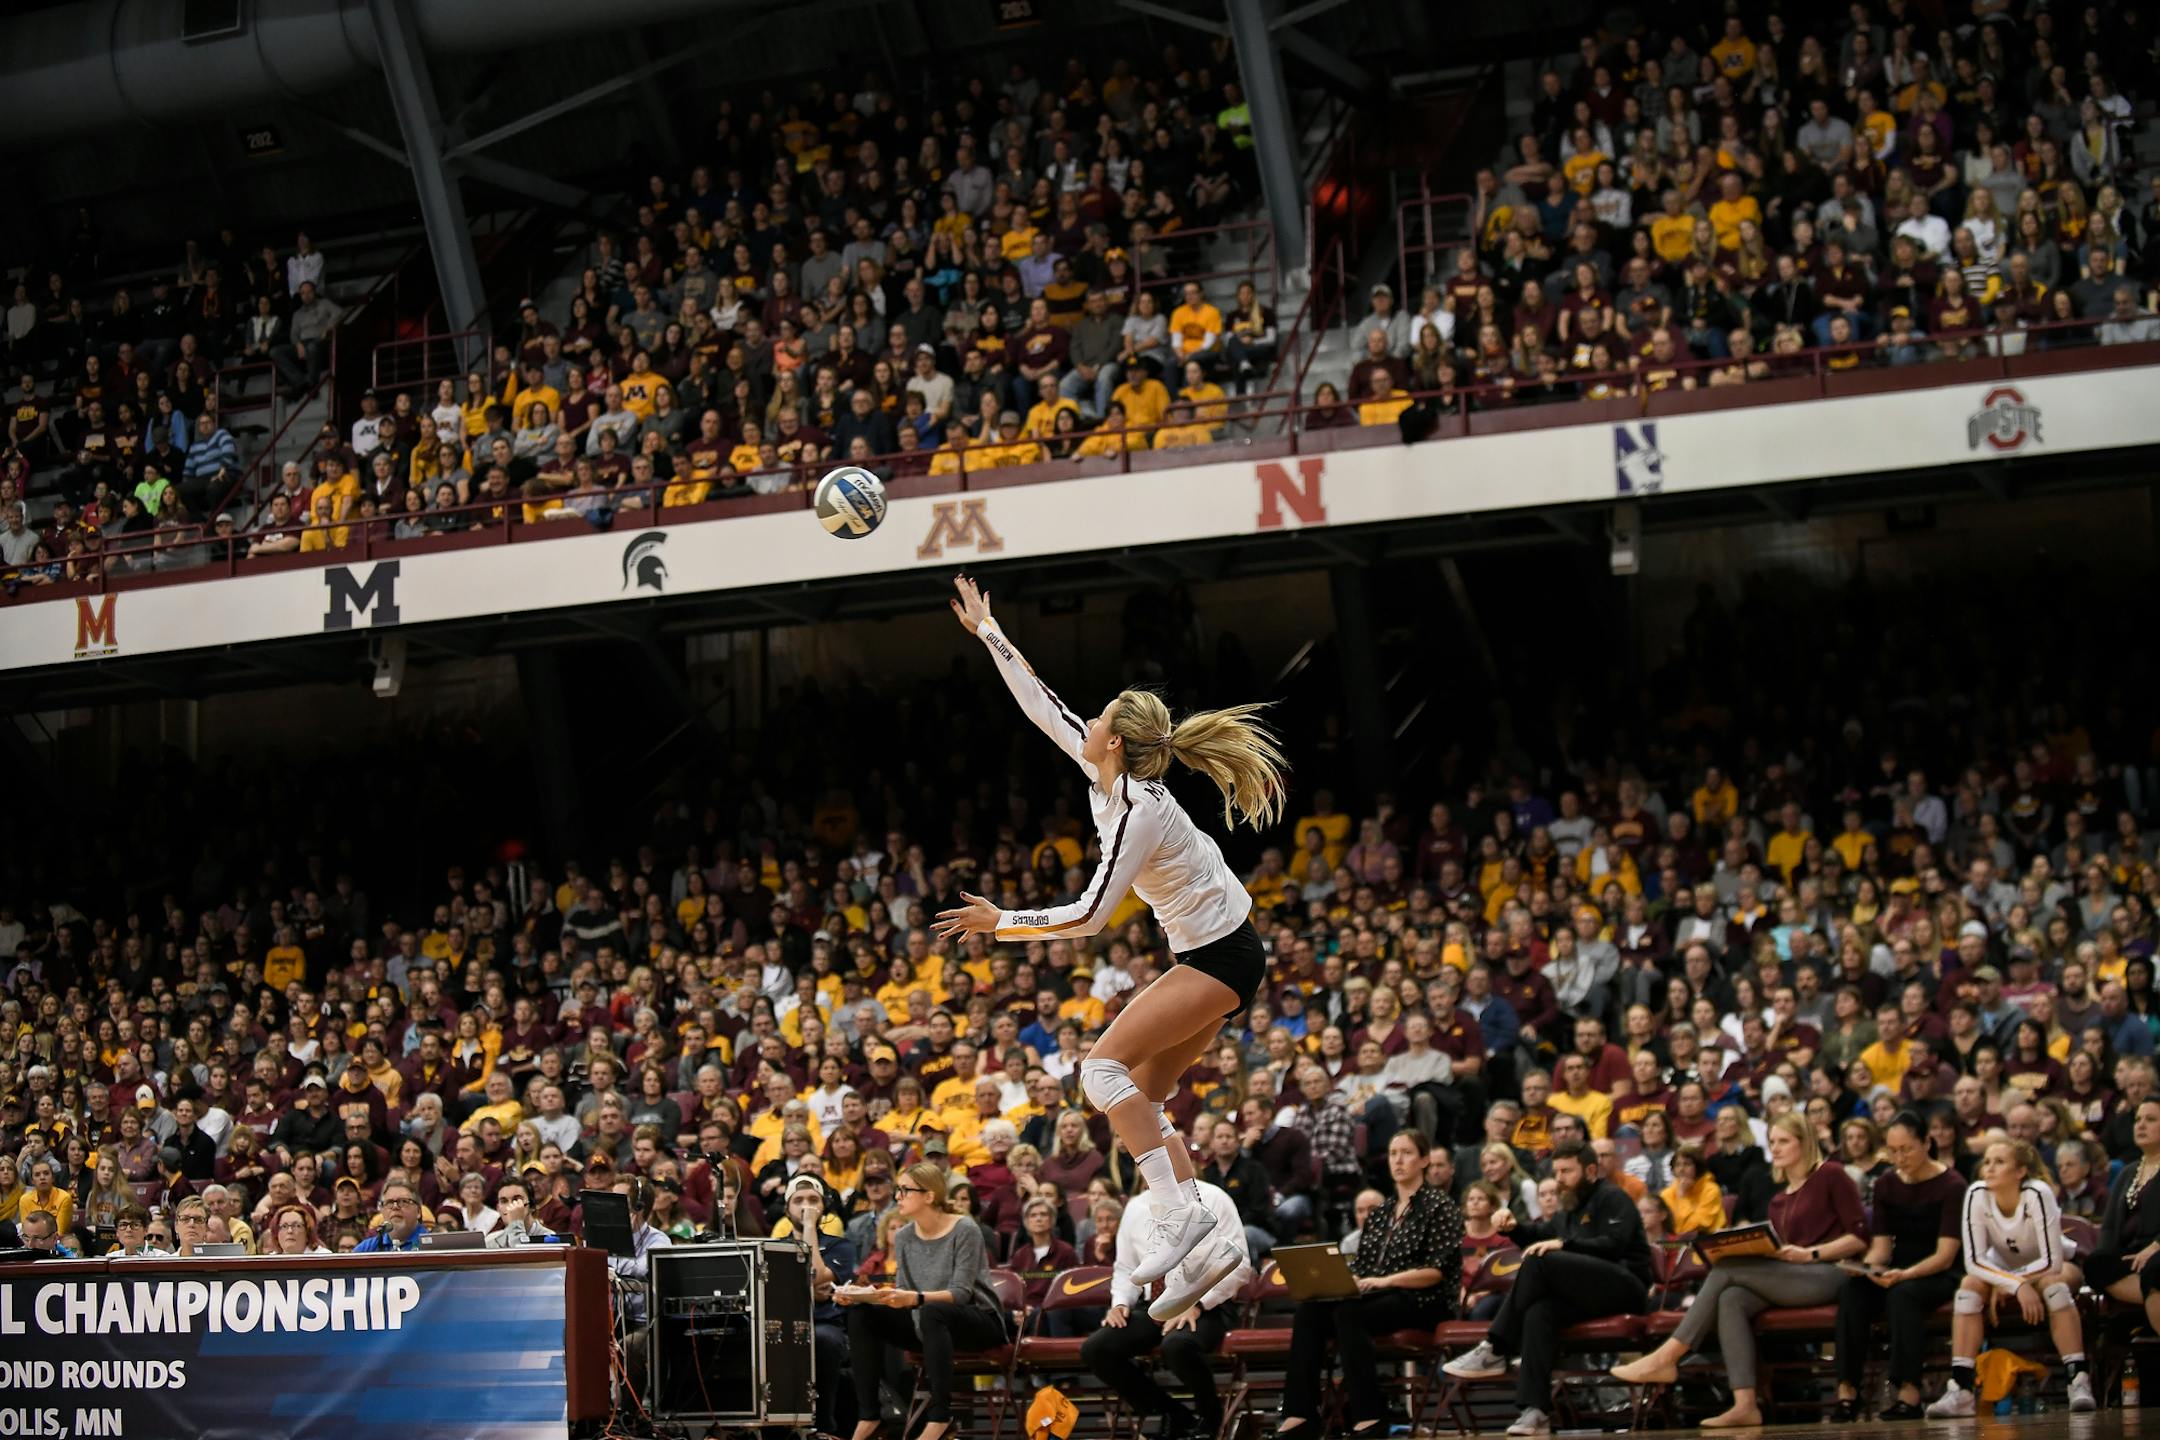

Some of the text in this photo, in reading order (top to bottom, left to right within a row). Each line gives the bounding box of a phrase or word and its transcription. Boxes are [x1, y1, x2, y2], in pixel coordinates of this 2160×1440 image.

[1255, 457, 1327, 530] N
[916, 498, 1004, 559] M
[75, 593, 118, 650] M
[323, 559, 400, 631] M
[985, 632, 1014, 662] GOLDEN
[1012, 914, 1050, 926] GOPHERS
[1, 1276, 420, 1335] L CHAMPIONSHIP
[61, 1360, 186, 1389] ROUNDS
[75, 1408, 123, 1437] MN
